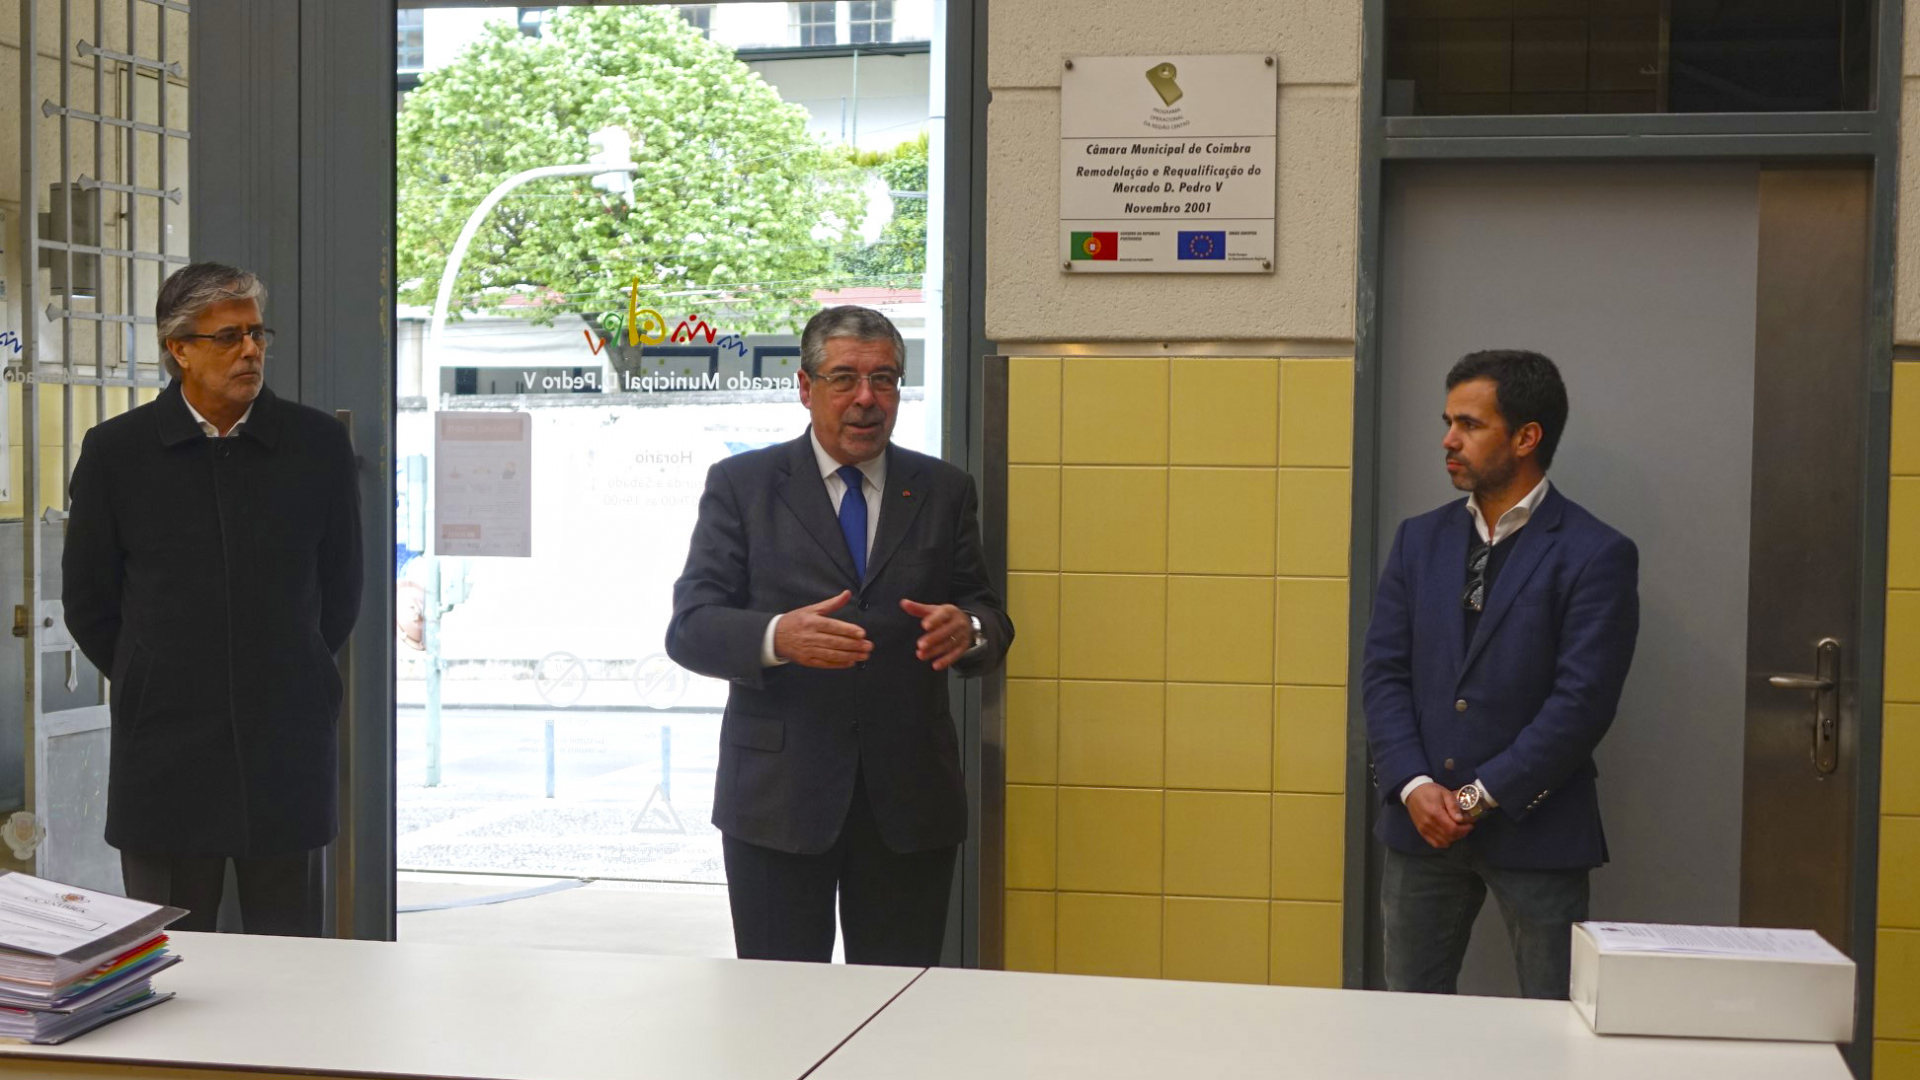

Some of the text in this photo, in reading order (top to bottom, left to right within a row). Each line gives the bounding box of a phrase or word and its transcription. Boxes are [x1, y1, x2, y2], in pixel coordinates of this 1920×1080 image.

[1171, 119, 1190, 130] CENTRO
[1086, 142, 1252, 157] Câmara Municipal de Coimbra
[1076, 164, 1262, 179] Remodelação e Requalificação do
[1113, 181, 1223, 193] Mercado D. Pedro V
[1124, 202, 1212, 214] Novembro 2001
